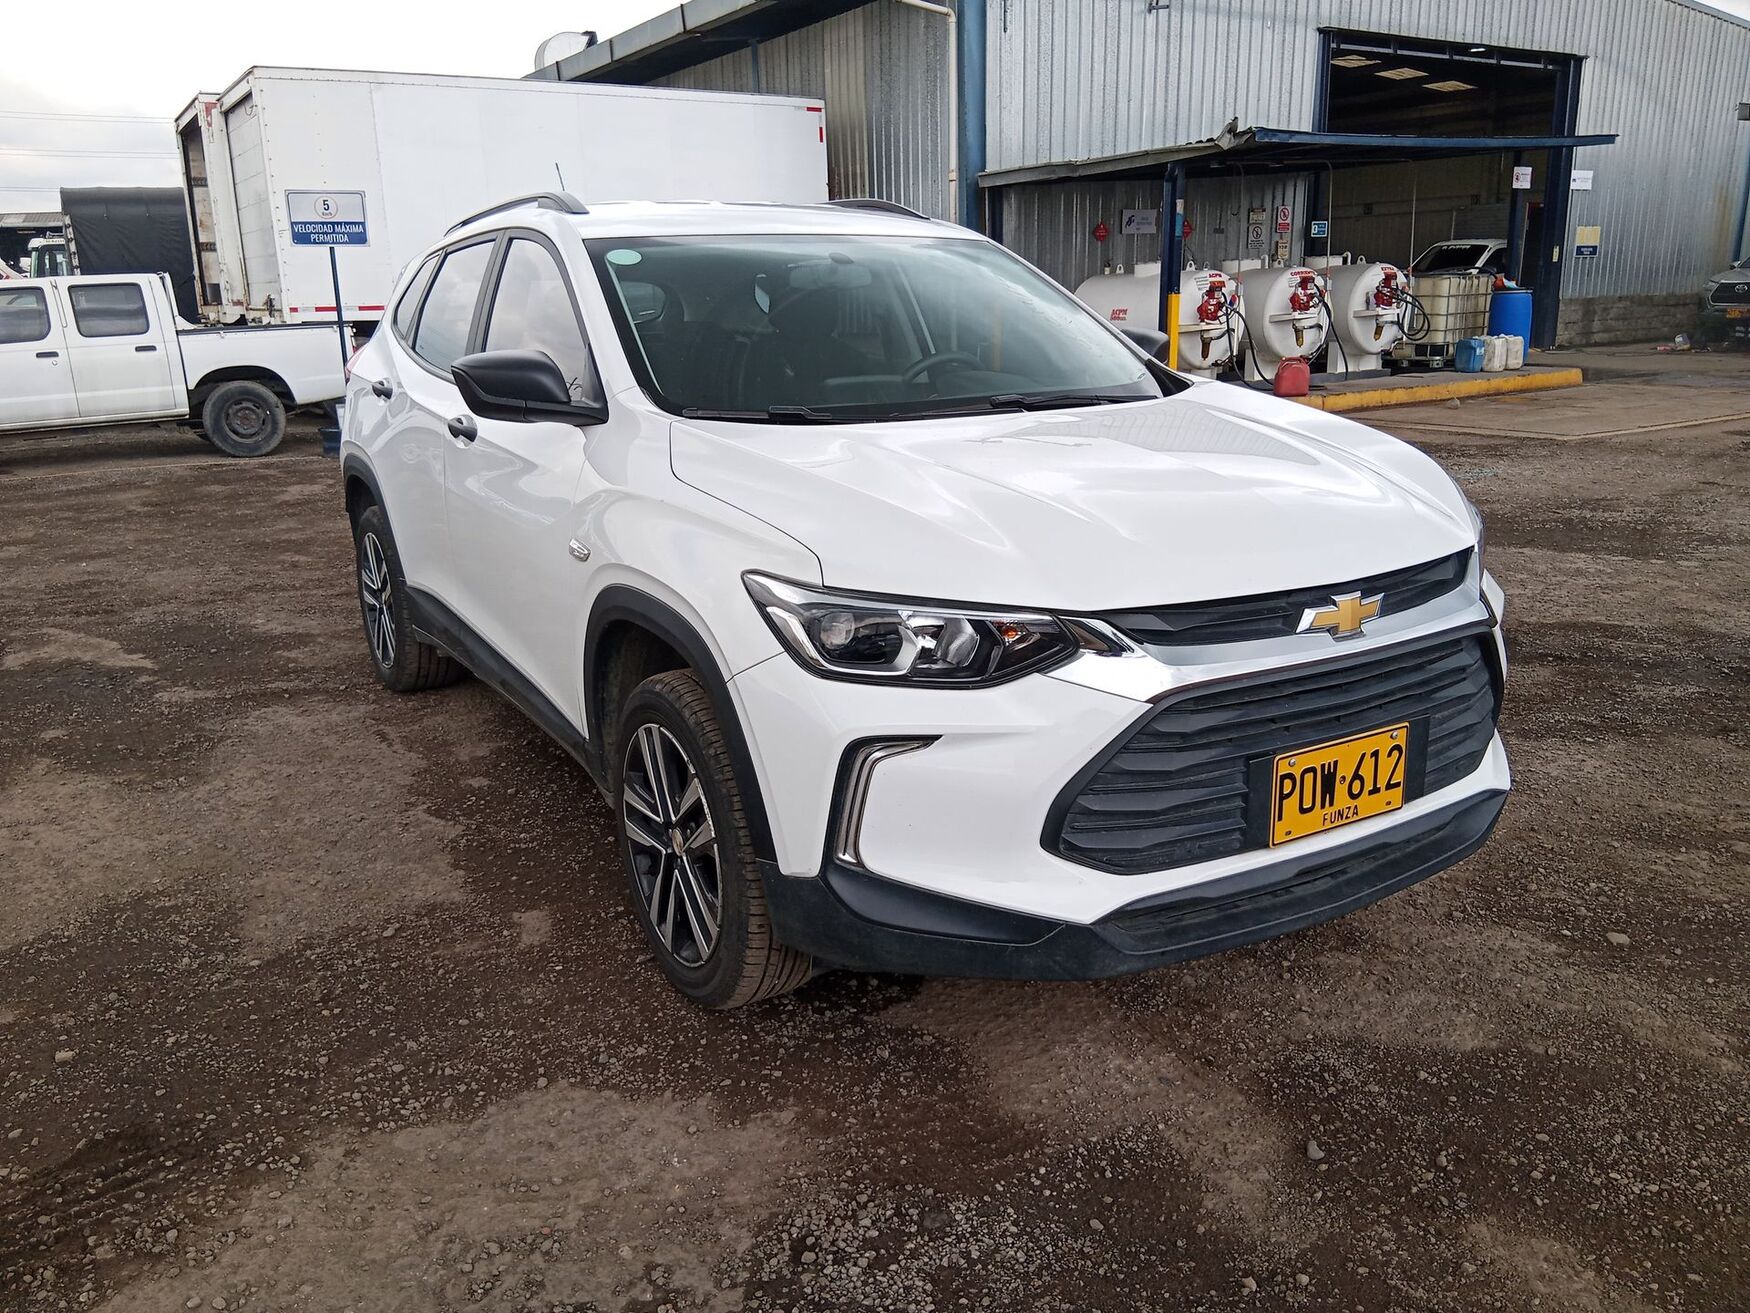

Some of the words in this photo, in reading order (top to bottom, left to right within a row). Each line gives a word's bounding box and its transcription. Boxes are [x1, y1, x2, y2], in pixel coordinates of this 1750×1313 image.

[322, 199, 330, 211] 5
[293, 223, 333, 233] VELOCIDAD
[335, 222, 364, 233] MÁXIMA
[310, 233, 349, 243] PERMITIDA
[1322, 804, 1359, 826] FUNZA
